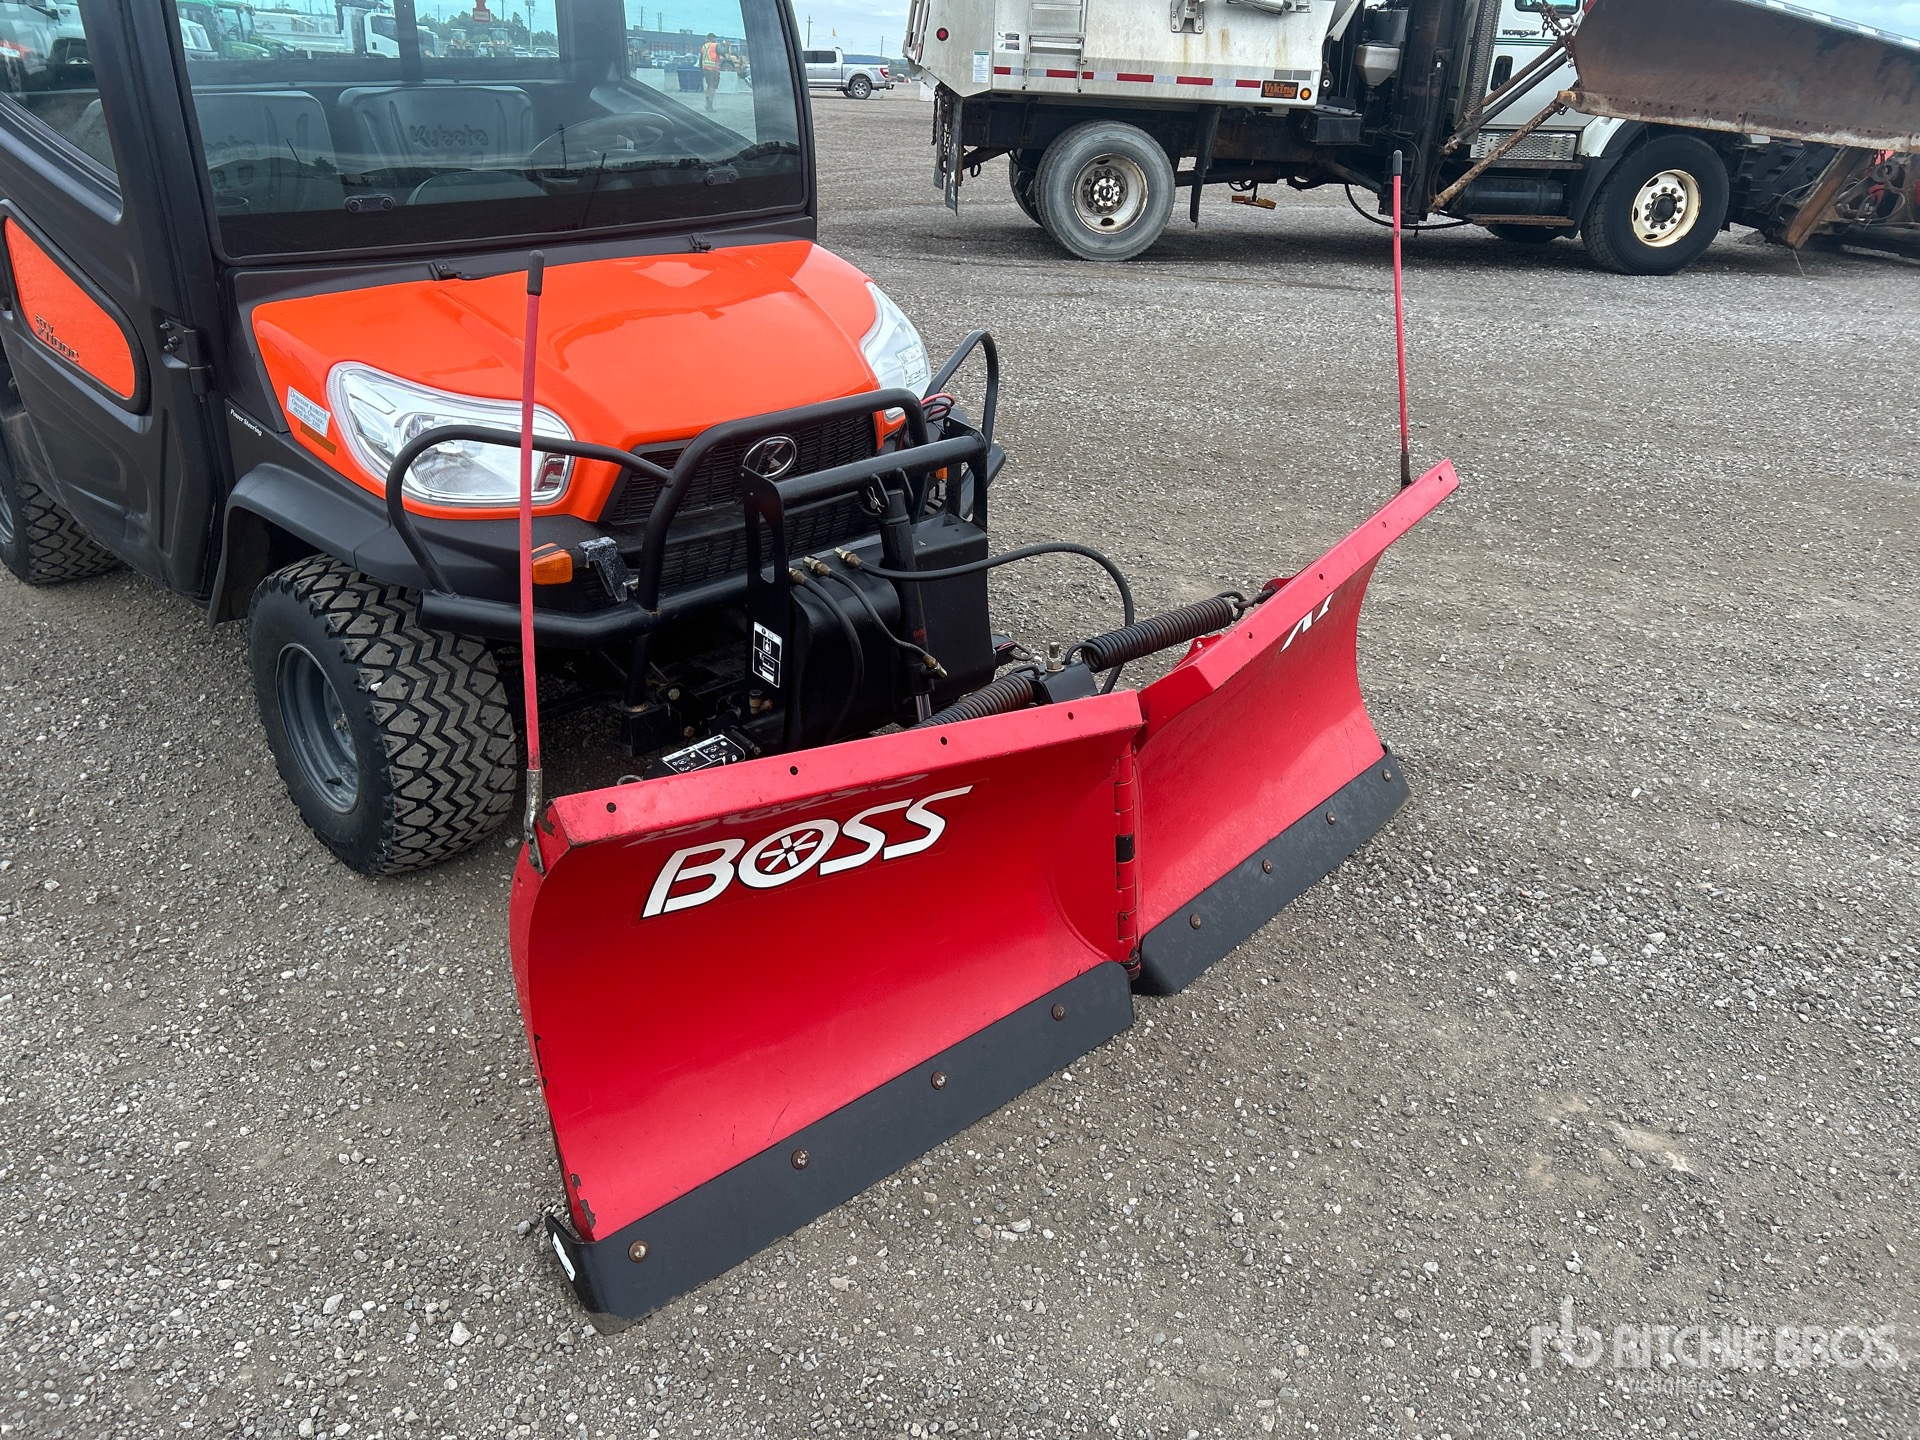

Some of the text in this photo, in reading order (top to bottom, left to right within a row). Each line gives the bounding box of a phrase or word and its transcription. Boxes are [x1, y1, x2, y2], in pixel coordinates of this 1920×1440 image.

[1264, 82, 1297, 97] Viking
[409, 124, 490, 148] Kubota
[230, 409, 263, 437] Power Steering
[641, 785, 972, 919] BOSS
